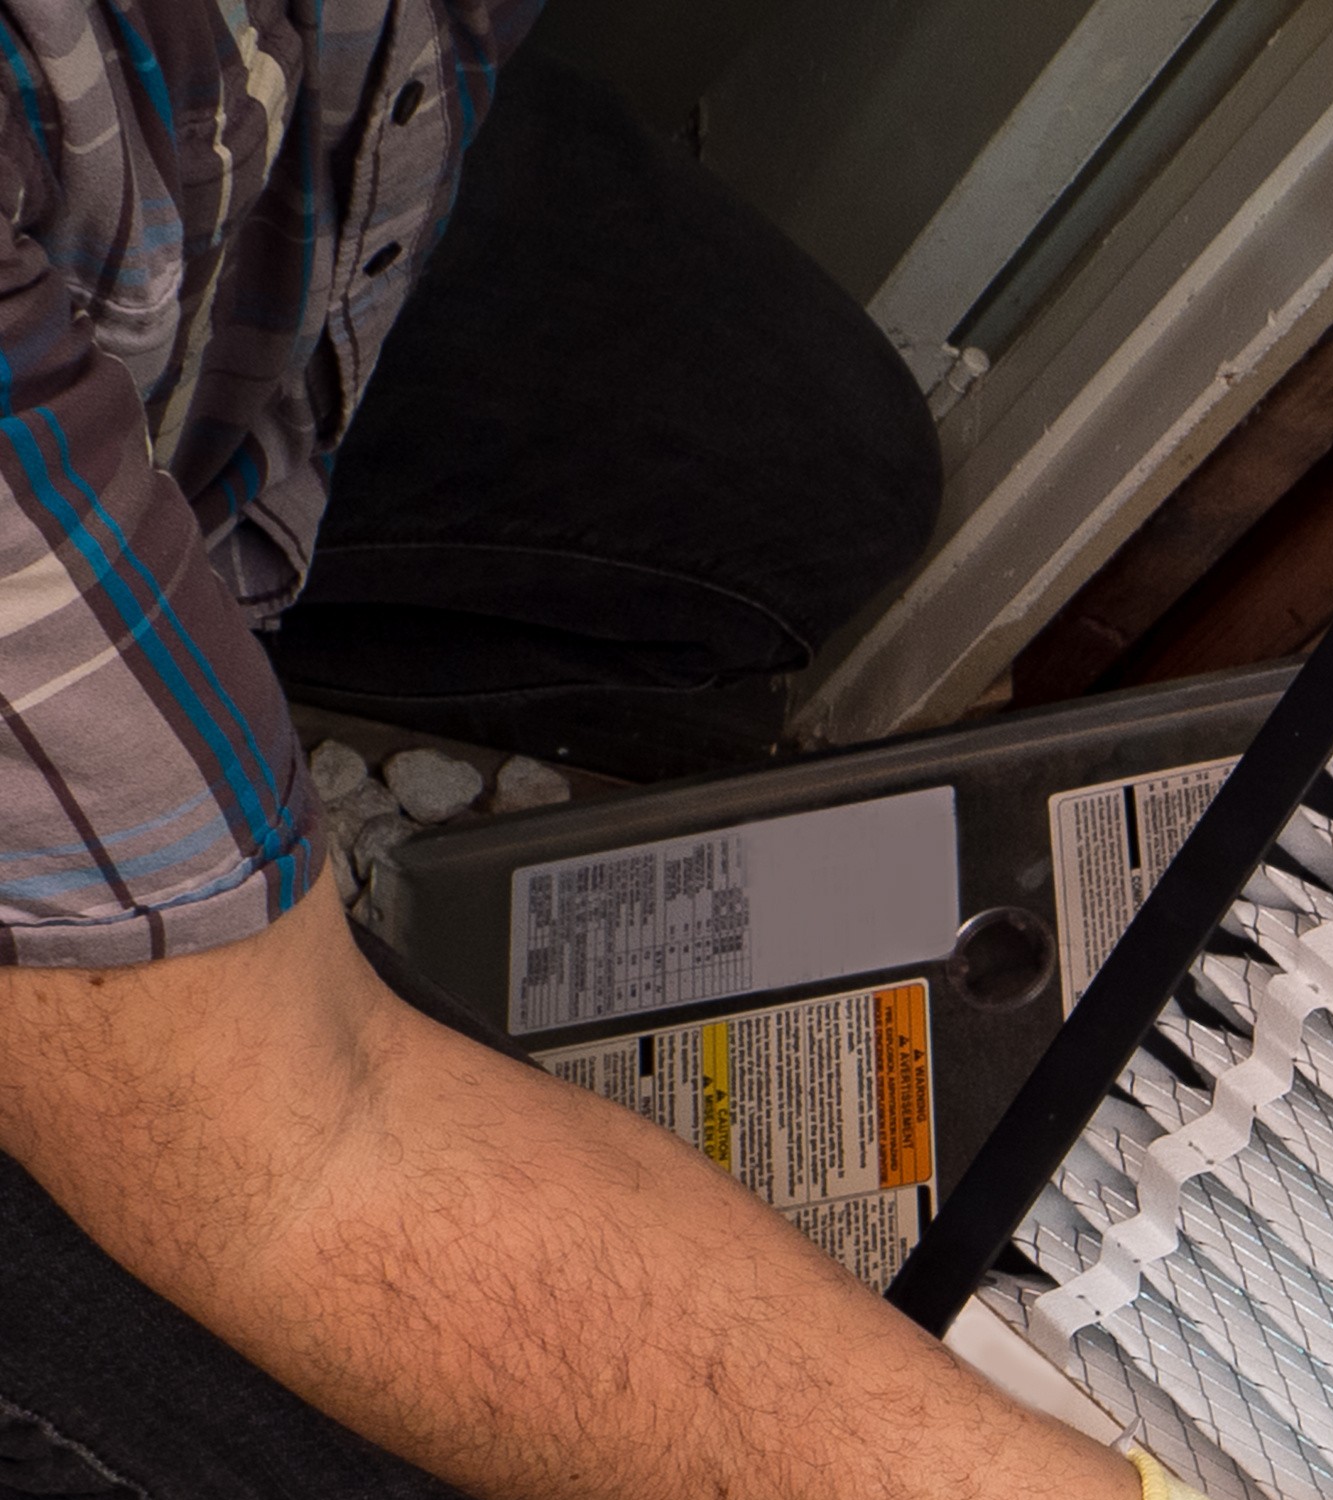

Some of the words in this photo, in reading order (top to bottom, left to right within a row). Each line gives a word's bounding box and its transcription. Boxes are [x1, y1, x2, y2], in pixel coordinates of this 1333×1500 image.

[703, 1094, 714, 1122] MISE
[899, 1051, 912, 1150] AVERTISSEMENT
[914, 1065, 926, 1123] WARNING
[704, 1124, 714, 1142] EN
[717, 1107, 728, 1161] CAUTION
